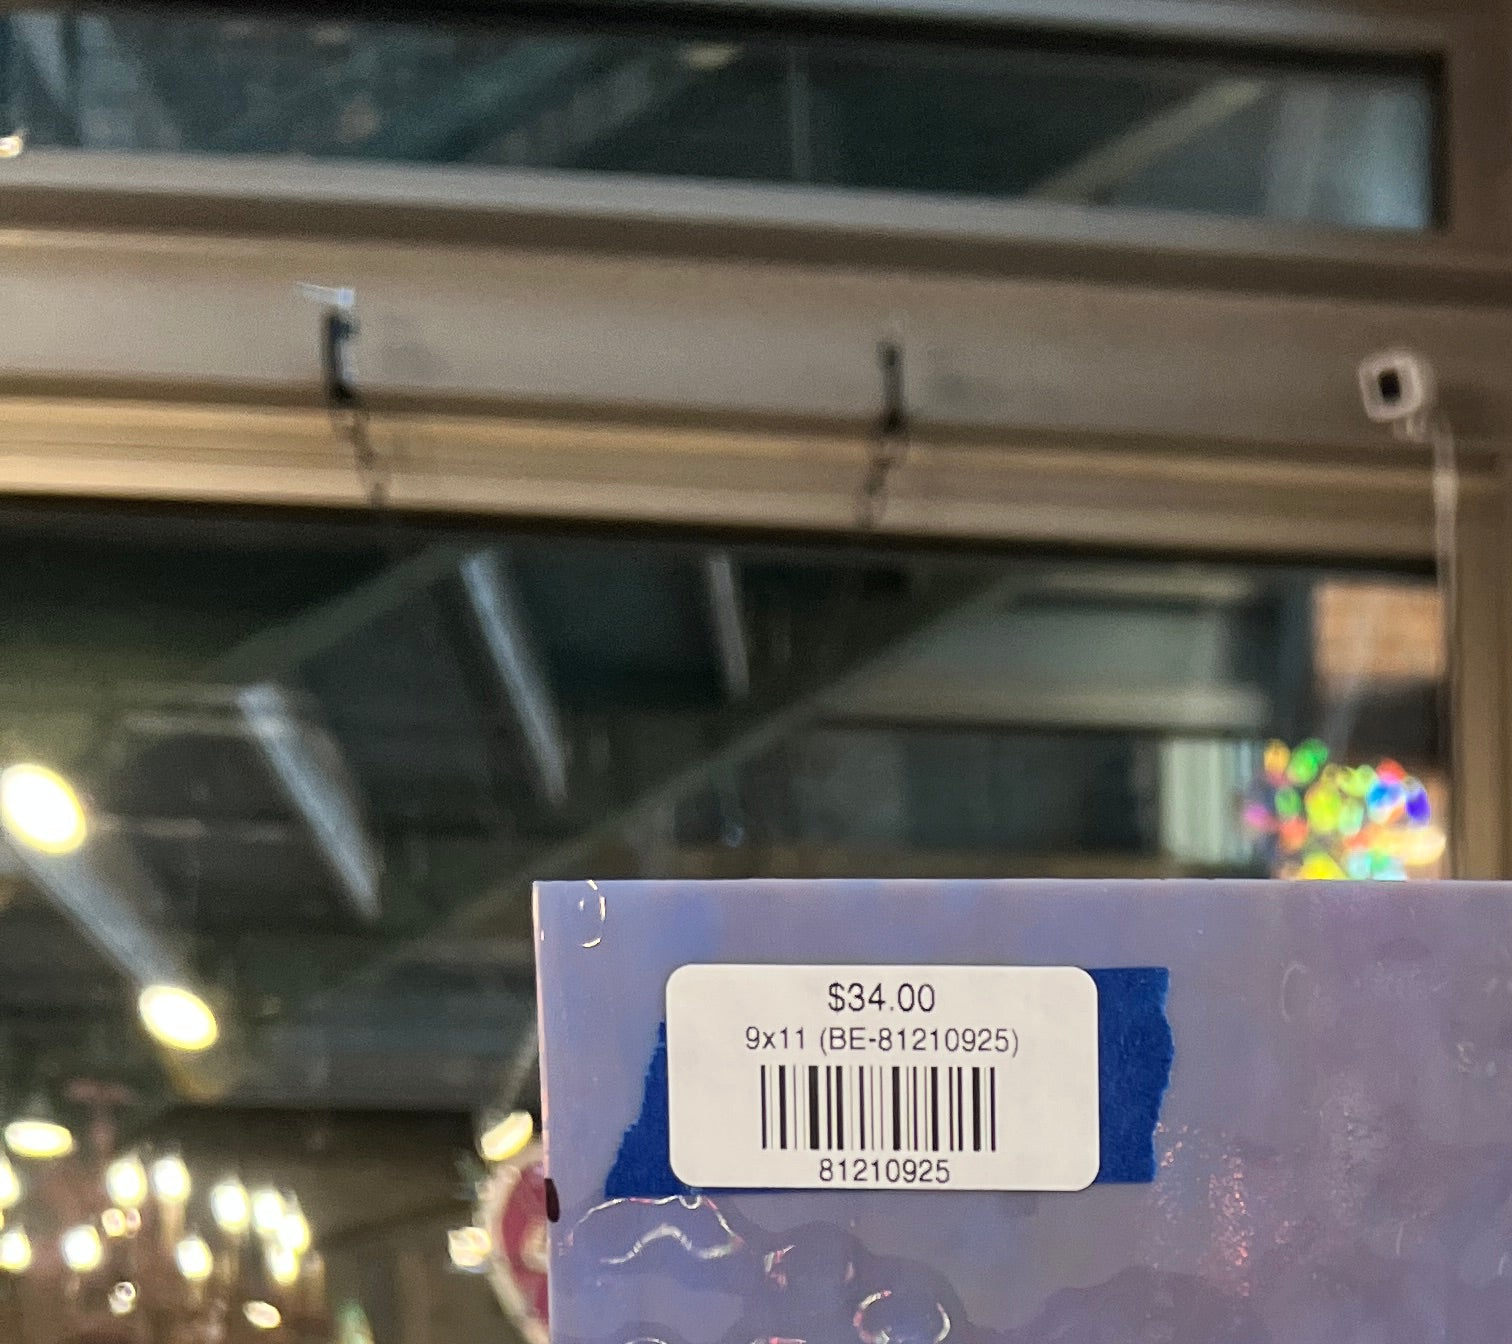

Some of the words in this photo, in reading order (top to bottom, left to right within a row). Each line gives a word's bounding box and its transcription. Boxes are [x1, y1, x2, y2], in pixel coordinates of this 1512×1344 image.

[828, 982, 936, 1013] $34.00
[745, 1026, 805, 1050] 9x11
[820, 1026, 1019, 1058] (BE-81210925)
[819, 1158, 951, 1184] 81210925
